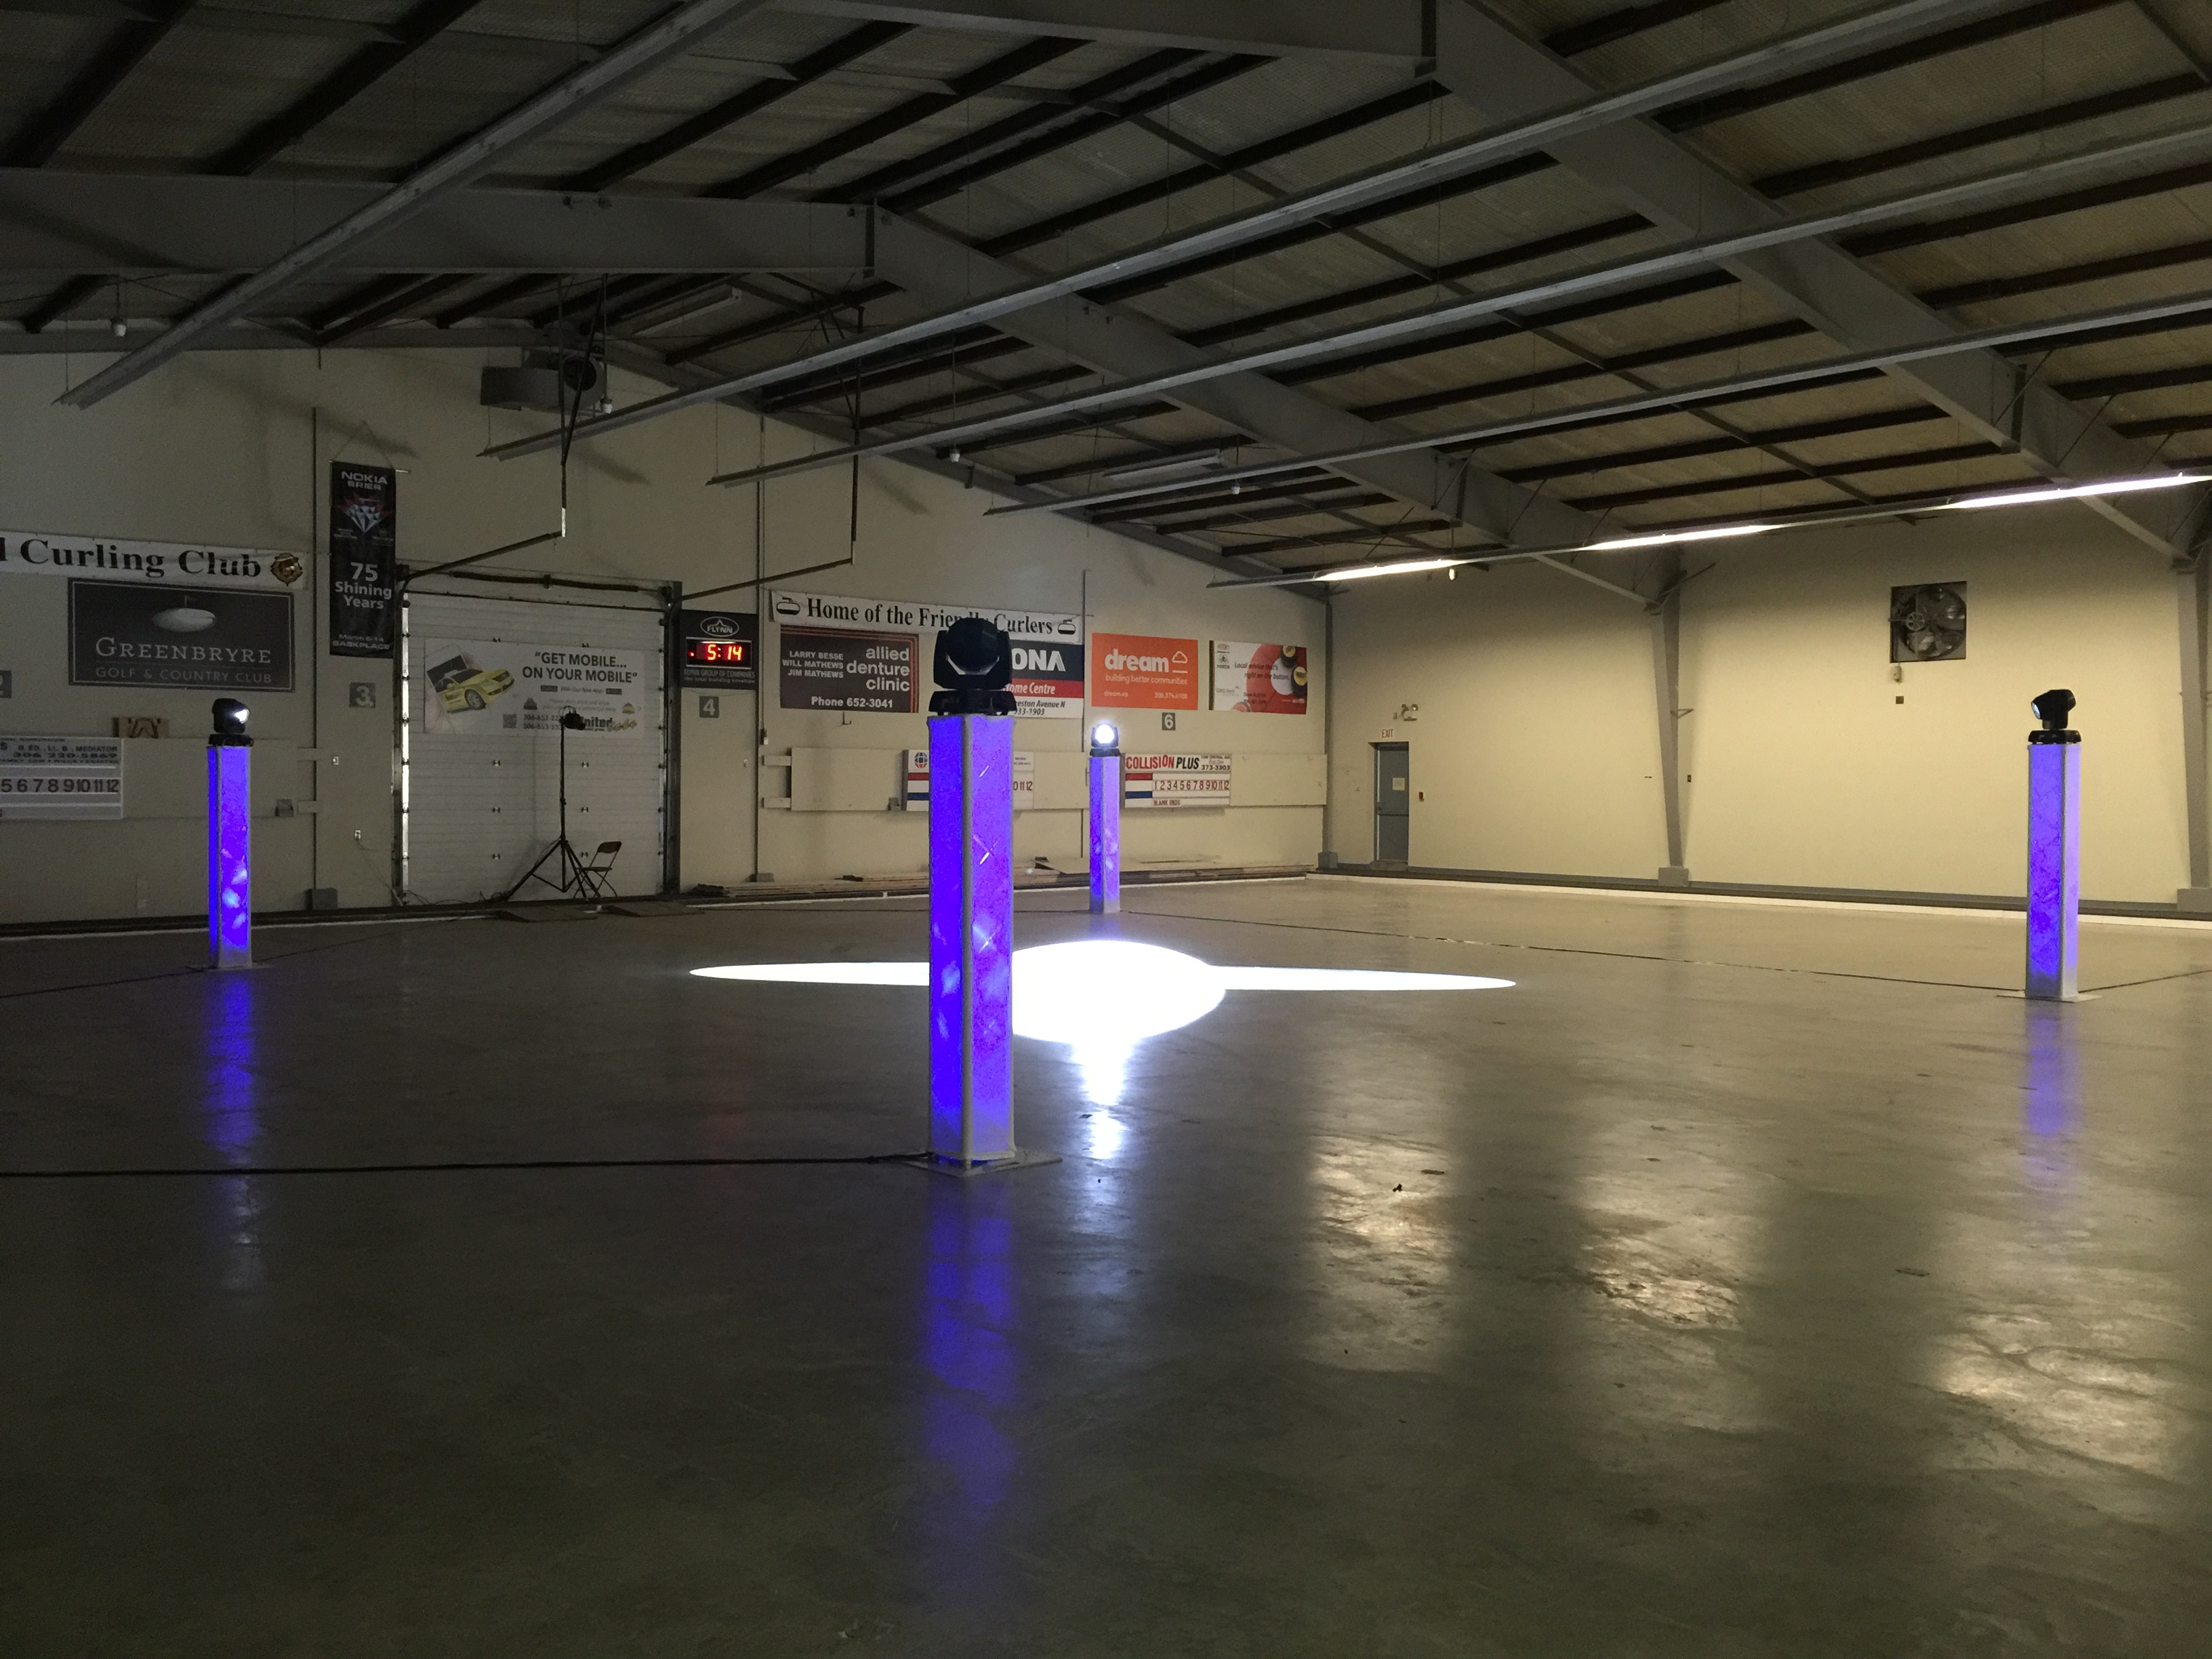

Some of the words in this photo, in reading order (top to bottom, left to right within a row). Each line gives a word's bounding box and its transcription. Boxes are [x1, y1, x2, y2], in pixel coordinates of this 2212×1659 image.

[342, 471, 388, 485] NOKIA
[348, 480, 382, 491] BRIER
[20, 539, 165, 577] Curling
[179, 550, 261, 577] Club
[350, 562, 378, 581] 75
[335, 581, 392, 600] Shining
[344, 595, 384, 609] Years
[806, 598, 859, 621] Home
[865, 604, 883, 623] of
[887, 605, 913, 626] the
[994, 613, 1053, 634] Curlers
[707, 626, 733, 634] FLYNN
[96, 637, 271, 663] GREENBRYRE
[708, 644, 742, 661] 5:14
[790, 651, 816, 659] LARRY
[818, 652, 844, 660] BESSE
[865, 646, 909, 661] allied
[569, 654, 627, 668] MOBILE...
[804, 660, 844, 669] MATHEWS
[1011, 648, 1066, 672] ONA
[1104, 649, 1169, 673] dream
[96, 667, 136, 678] GOLF
[144, 668, 152, 678] &
[160, 670, 229, 682] COUNTRY
[235, 672, 271, 683] CLUB
[522, 666, 543, 678] ON
[546, 668, 582, 680] YOUR
[586, 670, 638, 683] MOBILE"
[804, 670, 844, 678] MATHEWS
[846, 660, 910, 676] denture
[866, 677, 910, 692] clinic
[1105, 673, 1130, 684] building
[1131, 674, 1150, 683] better
[1151, 676, 1187, 685] communities
[355, 685, 370, 706] 3
[1029, 682, 1056, 695] Centre
[703, 698, 716, 716] 4
[811, 696, 844, 706] Phone
[846, 697, 893, 708] 652-3041
[1164, 714, 1174, 729] 6
[1382, 729, 1393, 738] EXIT
[1126, 754, 1174, 769] COLLISION
[1176, 756, 1200, 770] PLUS
[1, 779, 13, 793] 5
[17, 779, 28, 793] 6
[33, 779, 43, 793] 7
[47, 779, 59, 793] 8
[64, 779, 75, 793] 9
[77, 779, 91, 793] 10
[94, 779, 104, 793] 11
[106, 779, 119, 793] 12
[1020, 781, 1025, 791] 11
[1026, 781, 1033, 792] 12
[1154, 780, 1157, 791] 1
[1160, 780, 1165, 791] 2
[1167, 780, 1172, 791] 3
[1173, 780, 1178, 791] 4
[1180, 780, 1185, 791] 5
[1186, 780, 1191, 791] 6
[1193, 780, 1197, 791] 7
[1199, 780, 1204, 791] 8
[1206, 780, 1210, 791] 9
[1211, 780, 1218, 791] 10
[1218, 780, 1223, 791] 11
[1224, 780, 1229, 791] 12
